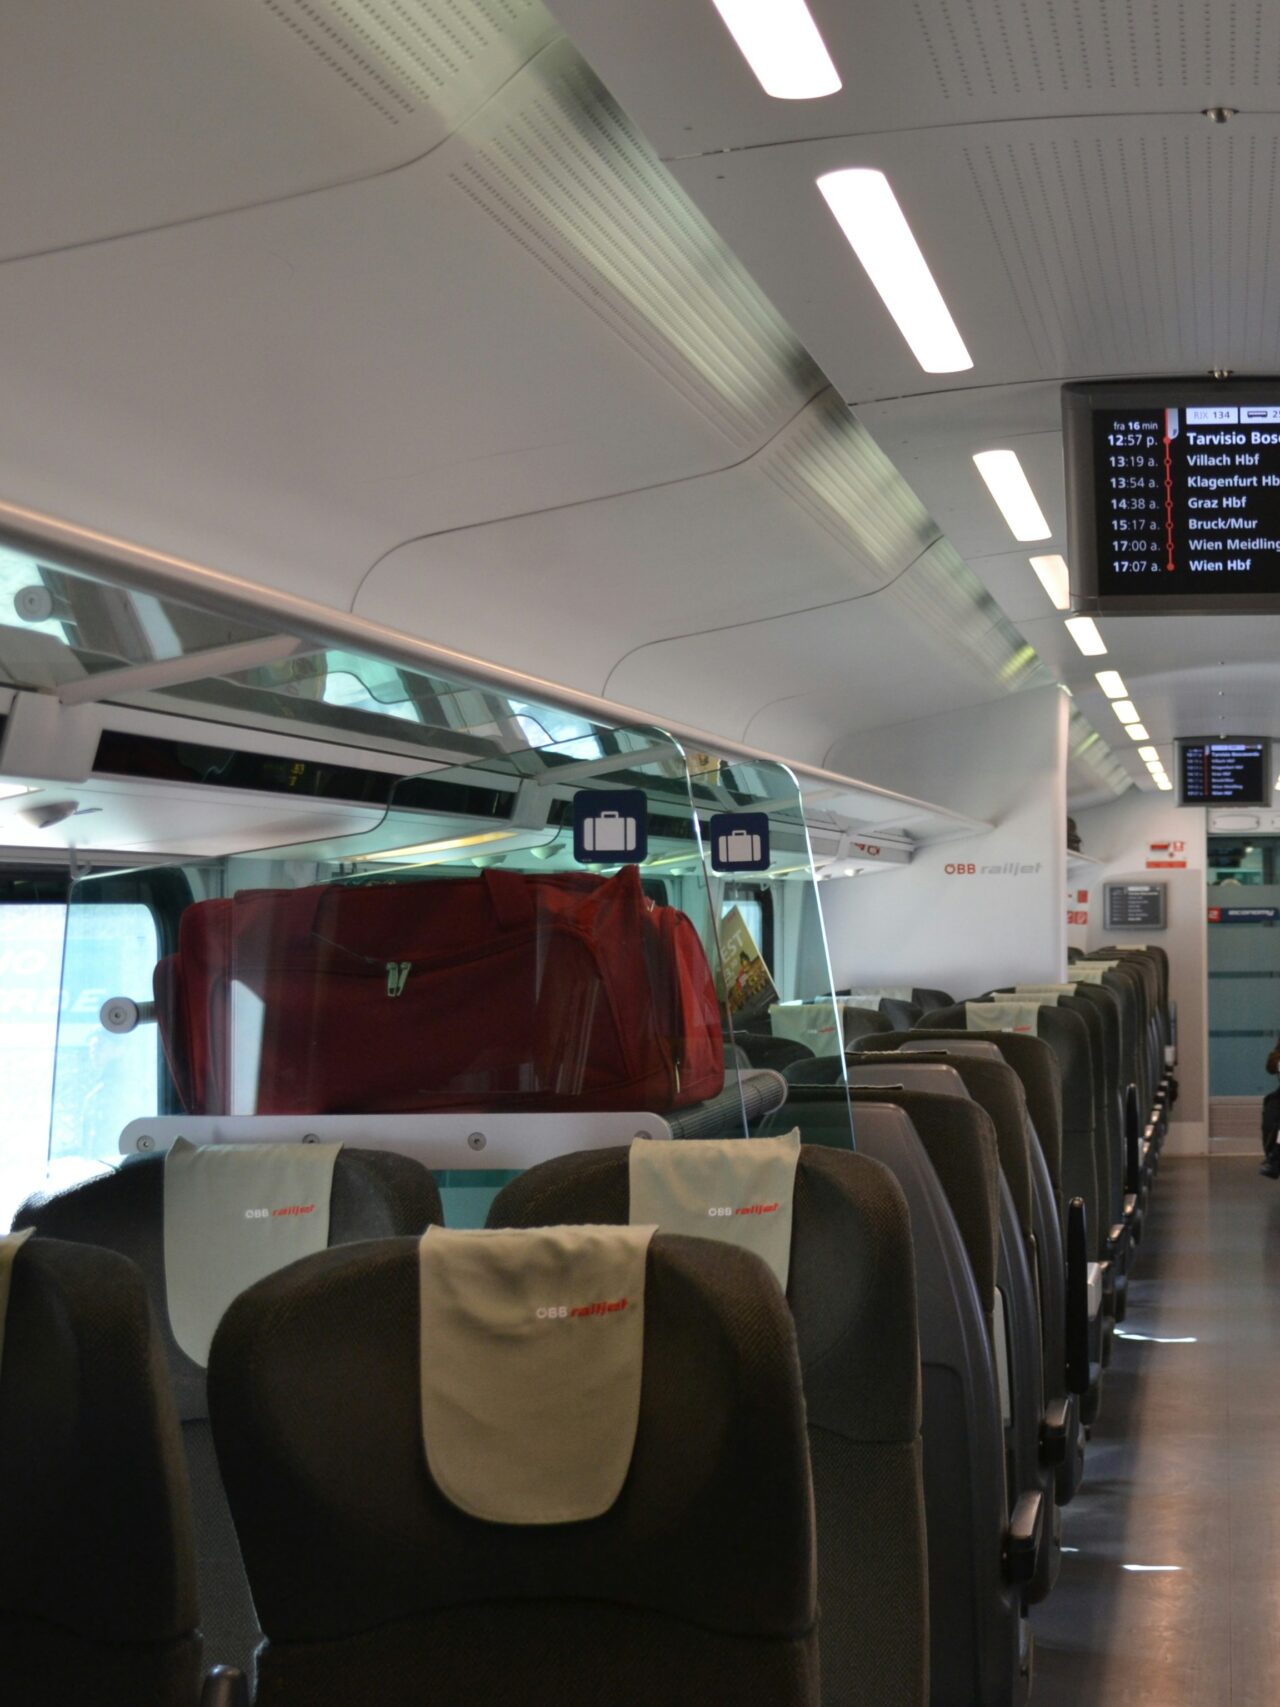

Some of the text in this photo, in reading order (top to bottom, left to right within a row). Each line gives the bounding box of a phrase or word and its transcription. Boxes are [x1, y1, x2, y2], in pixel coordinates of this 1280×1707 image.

[1213, 411, 1231, 419] 134
[1113, 421, 1159, 431] fra 16 min
[1107, 434, 1158, 448] 12:57 p.
[1186, 430, 1247, 446] Tarvisio
[1109, 456, 1158, 468] 13:19 a.
[1186, 453, 1260, 467] Villach Hbf
[1109, 477, 1159, 489] 13:54 a.
[1187, 475, 1258, 490] Klagenfurt
[1110, 498, 1160, 510] 14:38 a.
[1187, 496, 1248, 509] Graz Hbf
[1111, 519, 1160, 531] 15:17 a.
[1188, 517, 1259, 530] Bruck/Mur
[1112, 540, 1161, 552] 17:00 a.
[1188, 539, 1223, 551] Wien
[1113, 561, 1162, 573] 17:07 a.
[1189, 558, 1252, 571] Wien Hbf
[980, 861, 1042, 877] railjet
